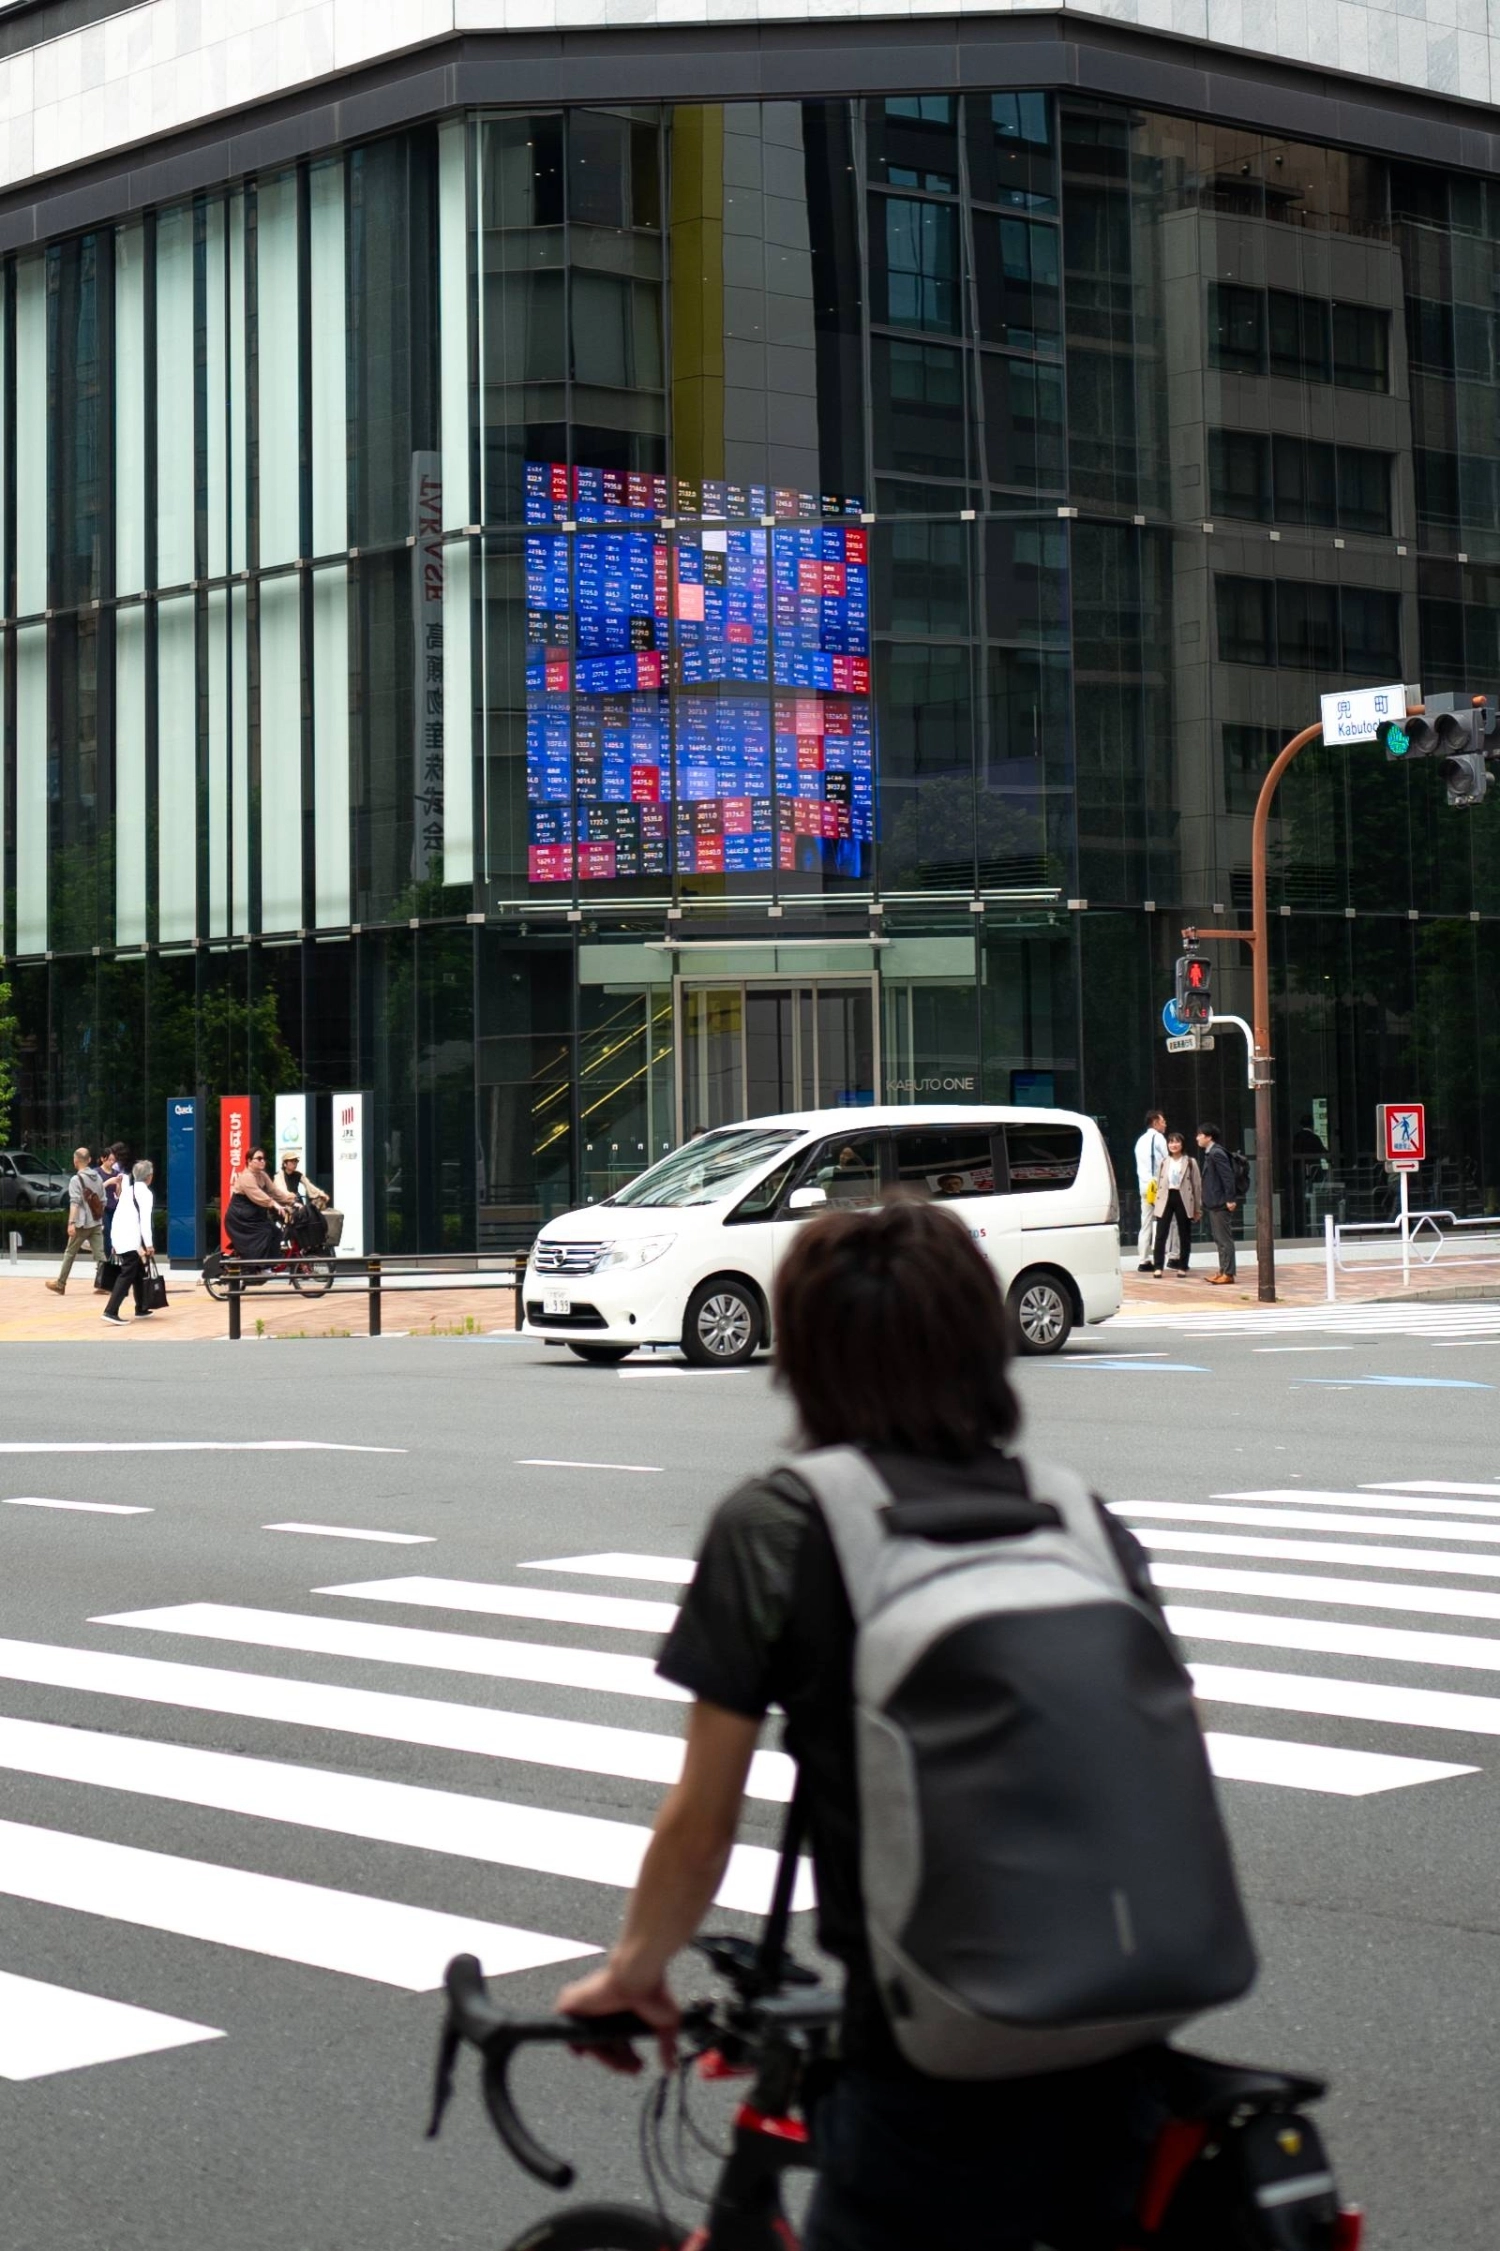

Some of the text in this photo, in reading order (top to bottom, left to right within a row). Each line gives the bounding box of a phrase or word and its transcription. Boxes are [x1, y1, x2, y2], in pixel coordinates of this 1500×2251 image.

[1337, 695, 1389, 720] 兜町
[1338, 718, 1381, 737] Kabutoc
[887, 1077, 975, 1092] KABUTO ONE
